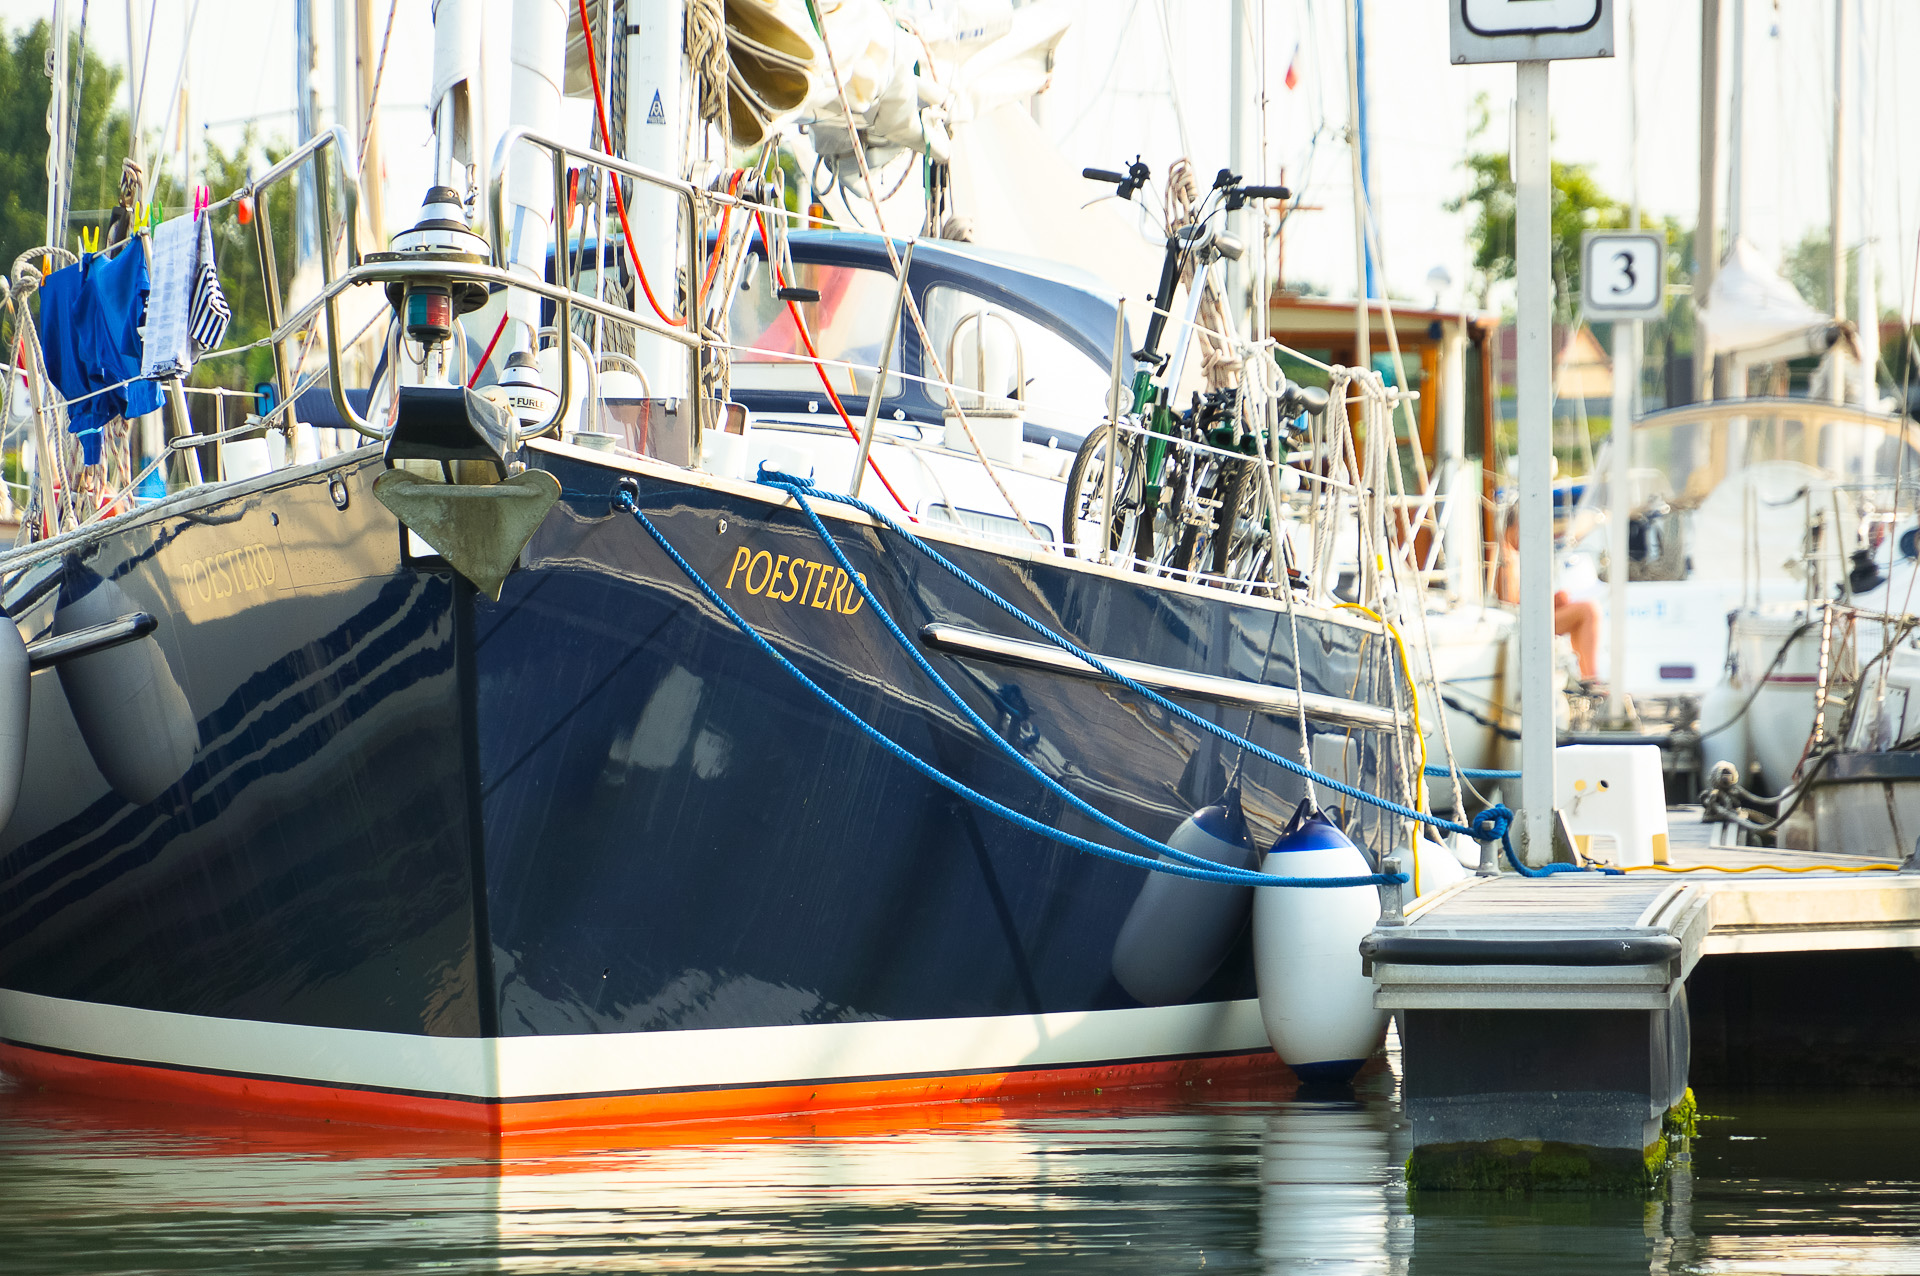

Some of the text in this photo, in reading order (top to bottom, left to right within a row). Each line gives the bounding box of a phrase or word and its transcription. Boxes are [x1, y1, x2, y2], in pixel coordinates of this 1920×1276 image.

[1610, 250, 1636, 295] 3
[182, 544, 276, 606] POESTERD
[725, 546, 868, 615] POESTERD
